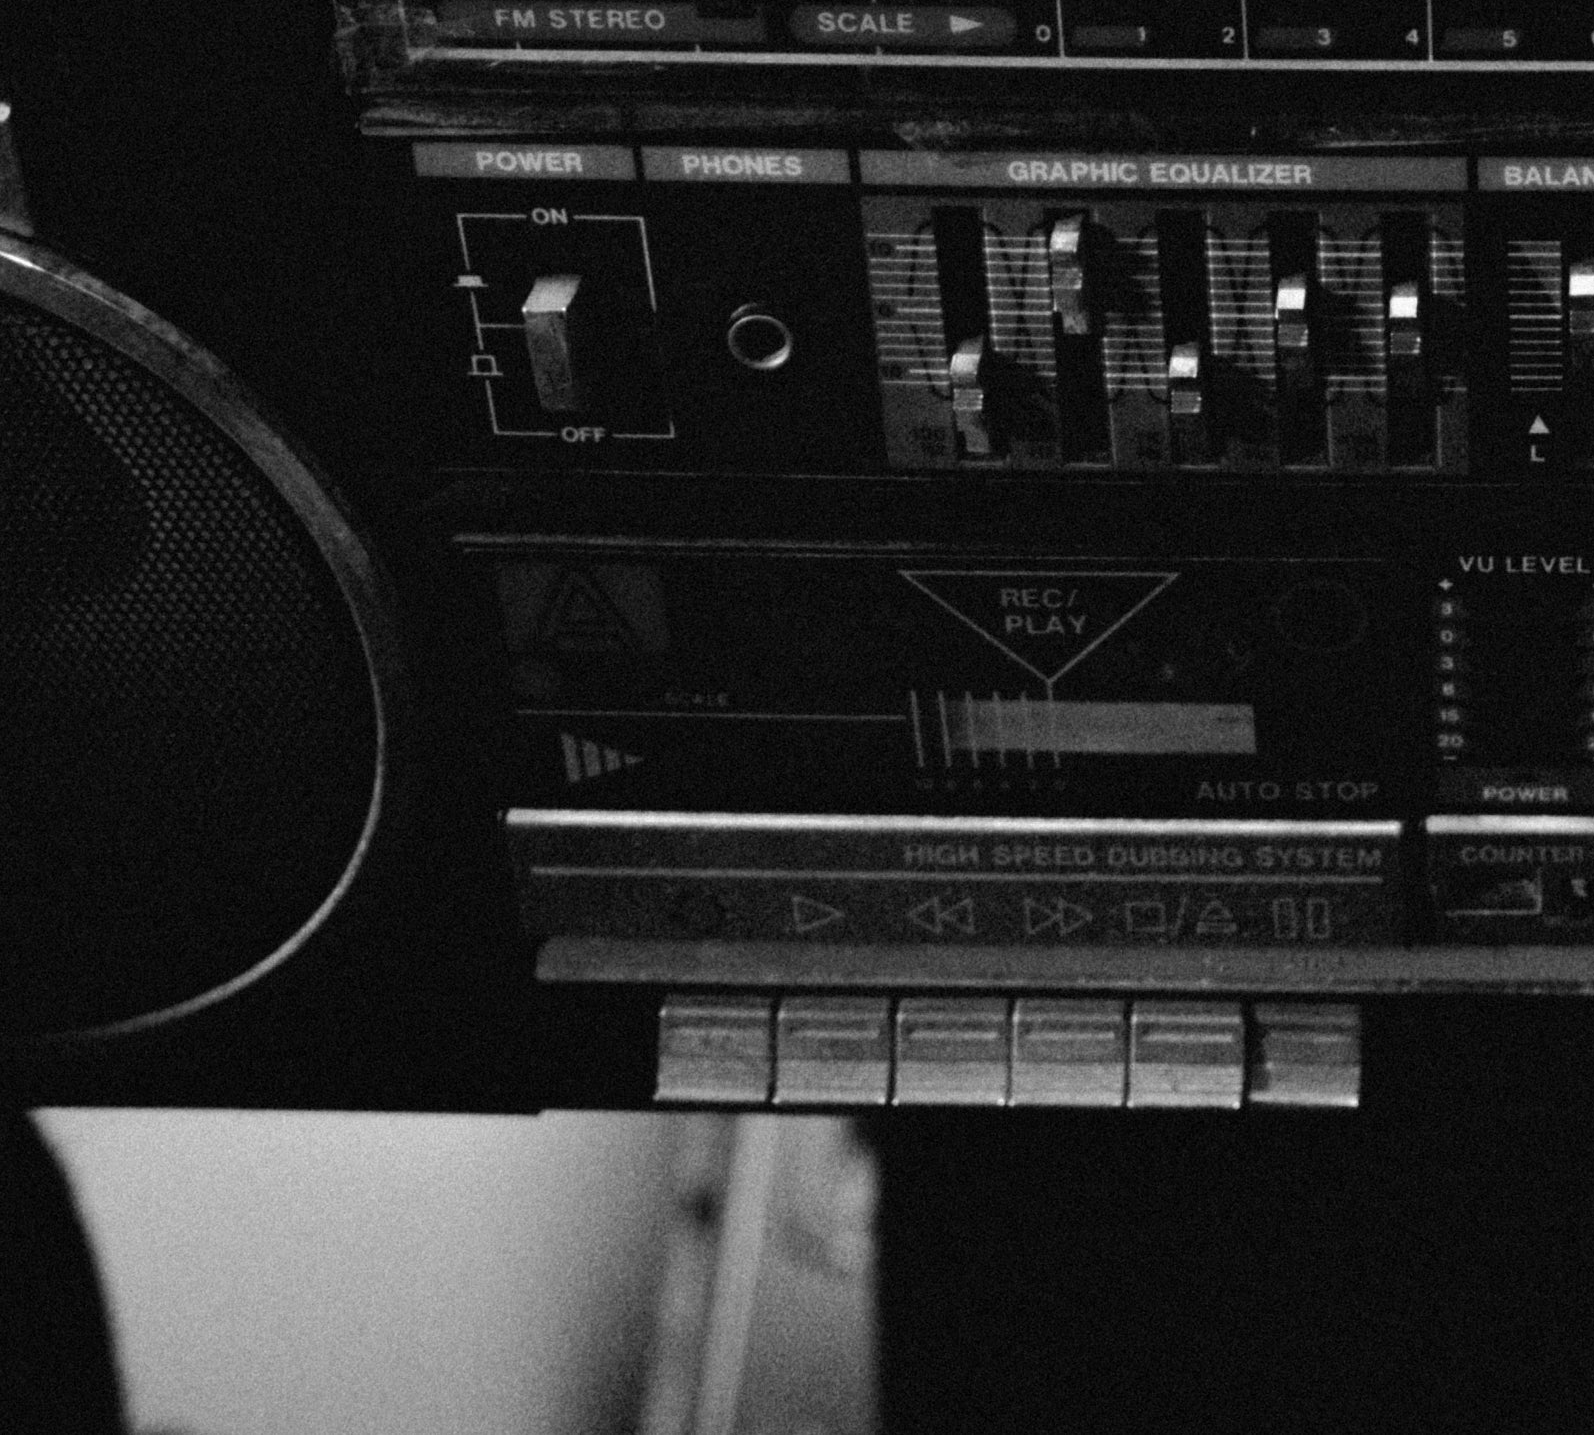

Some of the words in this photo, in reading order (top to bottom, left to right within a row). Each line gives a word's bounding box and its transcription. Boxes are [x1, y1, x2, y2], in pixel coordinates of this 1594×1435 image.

[494, 9, 536, 30] FM
[548, 9, 667, 31] STEREO
[816, 11, 915, 34] SCALE
[1222, 27, 1236, 45] 2
[1317, 28, 1333, 47] 3
[1404, 29, 1420, 46] 4
[1502, 30, 1517, 49] 5
[475, 151, 584, 175] POWER
[681, 153, 803, 177] PHONES
[1007, 160, 1139, 183] GRAPHIC
[1149, 162, 1313, 186] EQUALIZER
[531, 207, 569, 226] ON
[560, 427, 606, 444] OFF
[1530, 444, 1546, 463] L
[1458, 555, 1495, 573] VU
[1505, 555, 1592, 575] LEVEL
[1004, 614, 1088, 635] PLAY
[1197, 779, 1282, 802] AUTO
[1295, 780, 1381, 802] STOP
[1482, 785, 1570, 803] POWER
[902, 845, 980, 866] HIGH
[991, 845, 1095, 867] SPEED
[1254, 846, 1383, 868] SYSTEM
